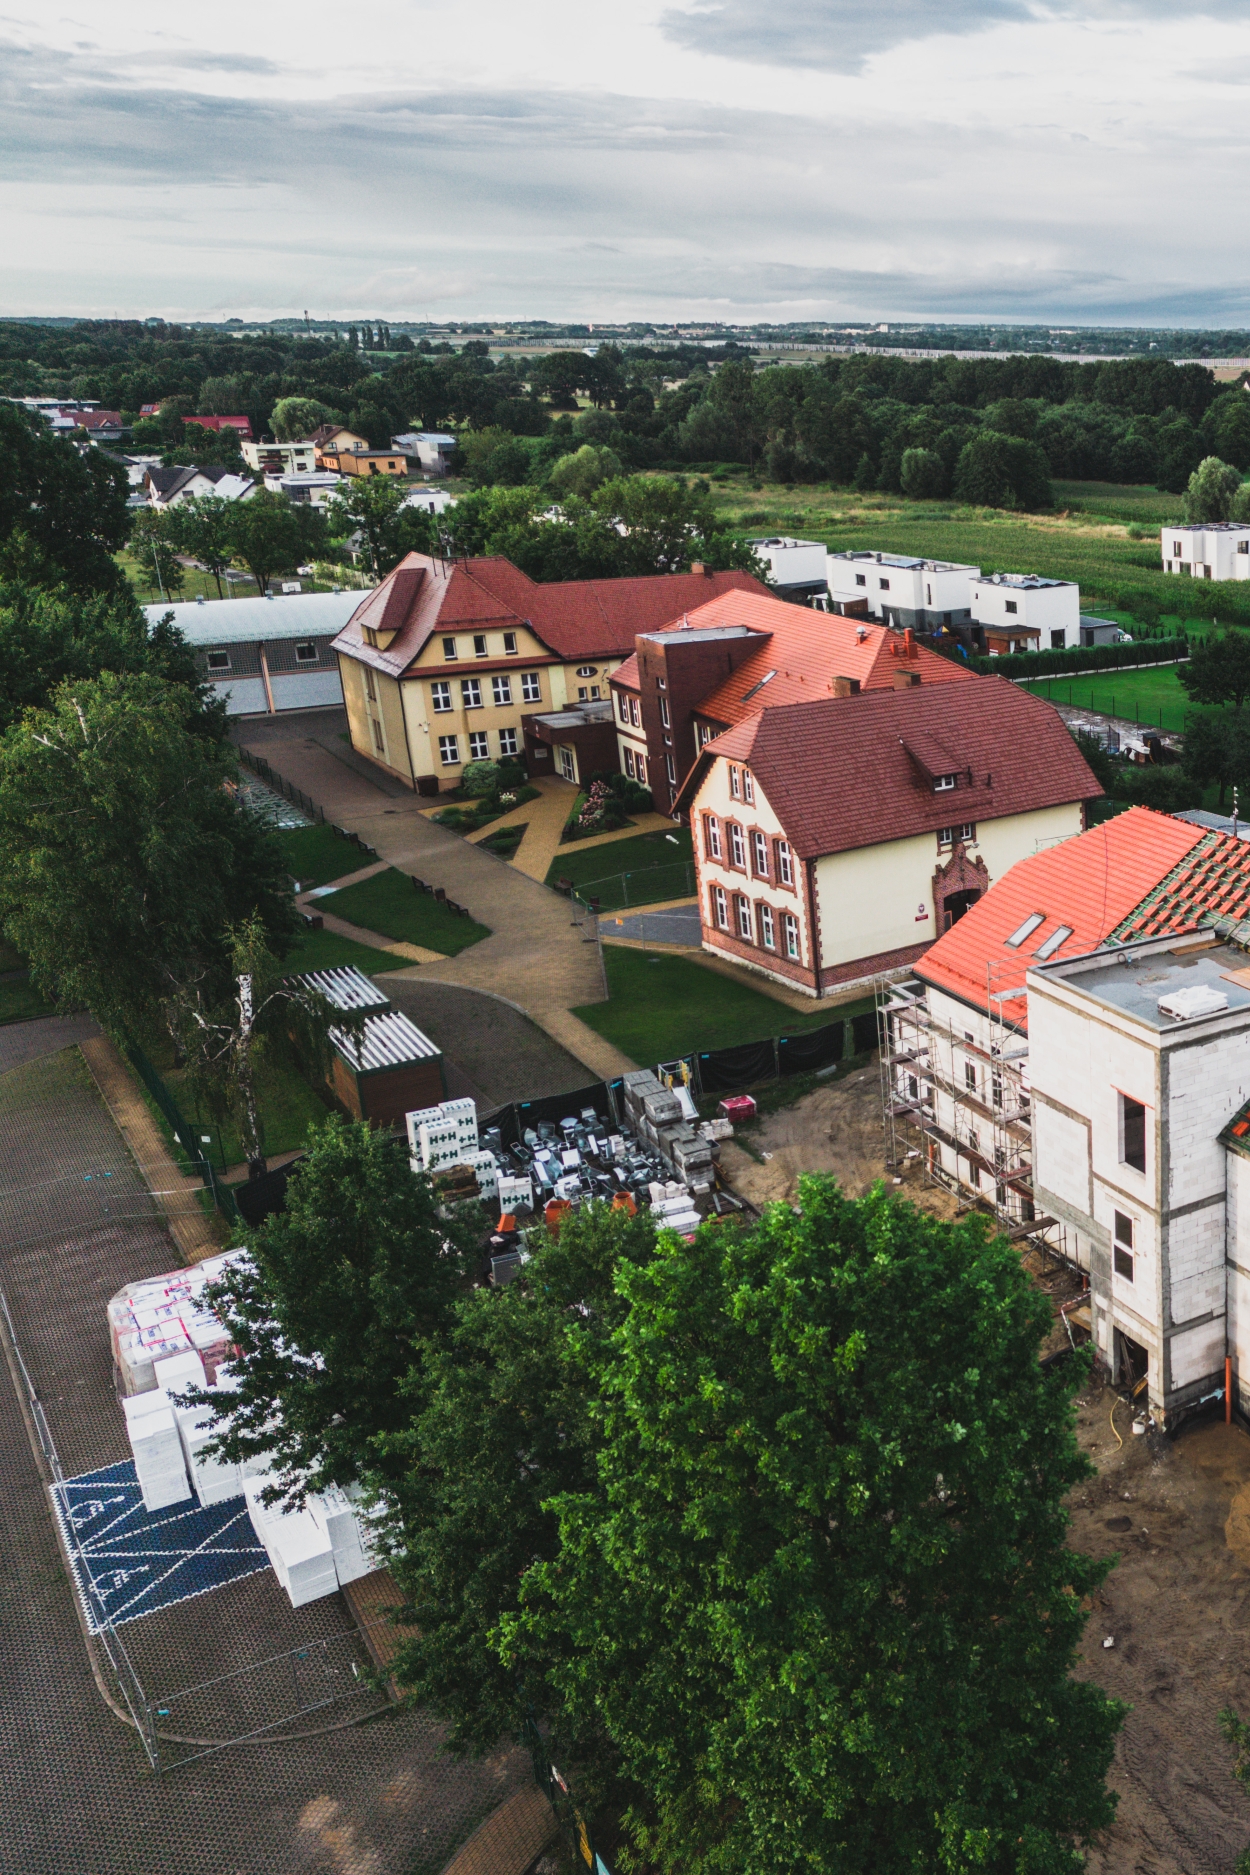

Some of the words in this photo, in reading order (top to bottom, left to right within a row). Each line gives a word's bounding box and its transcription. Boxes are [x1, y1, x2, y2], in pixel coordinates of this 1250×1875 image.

[458, 1116, 473, 1126] +H
[430, 1131, 457, 1145] H+H
[459, 1134, 475, 1144] +H
[475, 1161, 492, 1171] +H
[479, 1178, 494, 1188] +H
[502, 1193, 530, 1205] H+H
